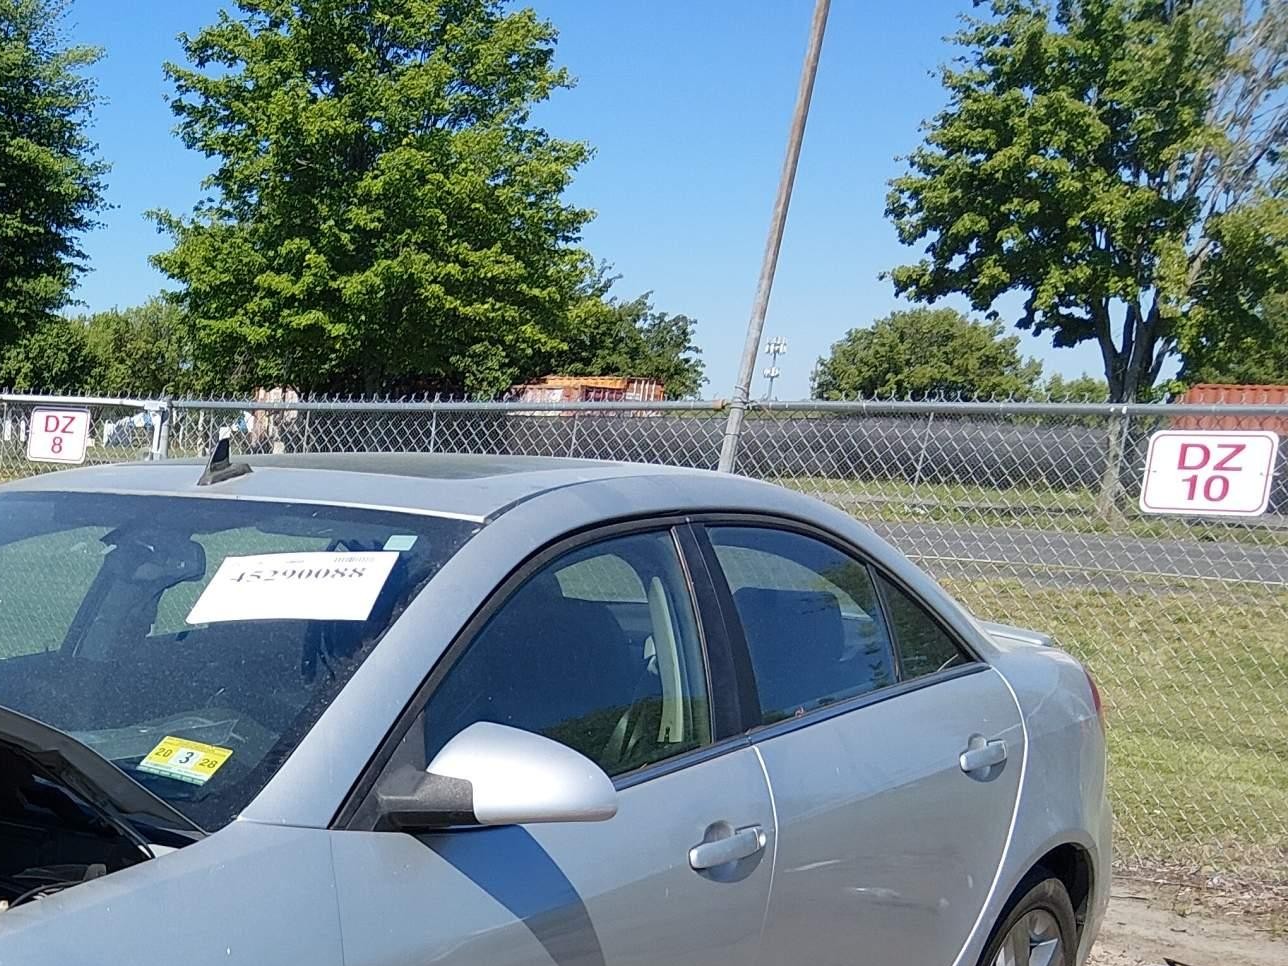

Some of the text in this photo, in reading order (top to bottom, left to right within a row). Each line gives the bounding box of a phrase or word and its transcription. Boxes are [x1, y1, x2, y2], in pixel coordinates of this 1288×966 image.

[44, 415, 76, 434] DZ
[51, 436, 63, 454] 8
[1177, 443, 1247, 471] DZ
[1181, 474, 1230, 502] 10
[229, 567, 367, 583] 45290088
[155, 747, 173, 758] 20
[179, 751, 194, 764] 3
[199, 758, 218, 769] 28
